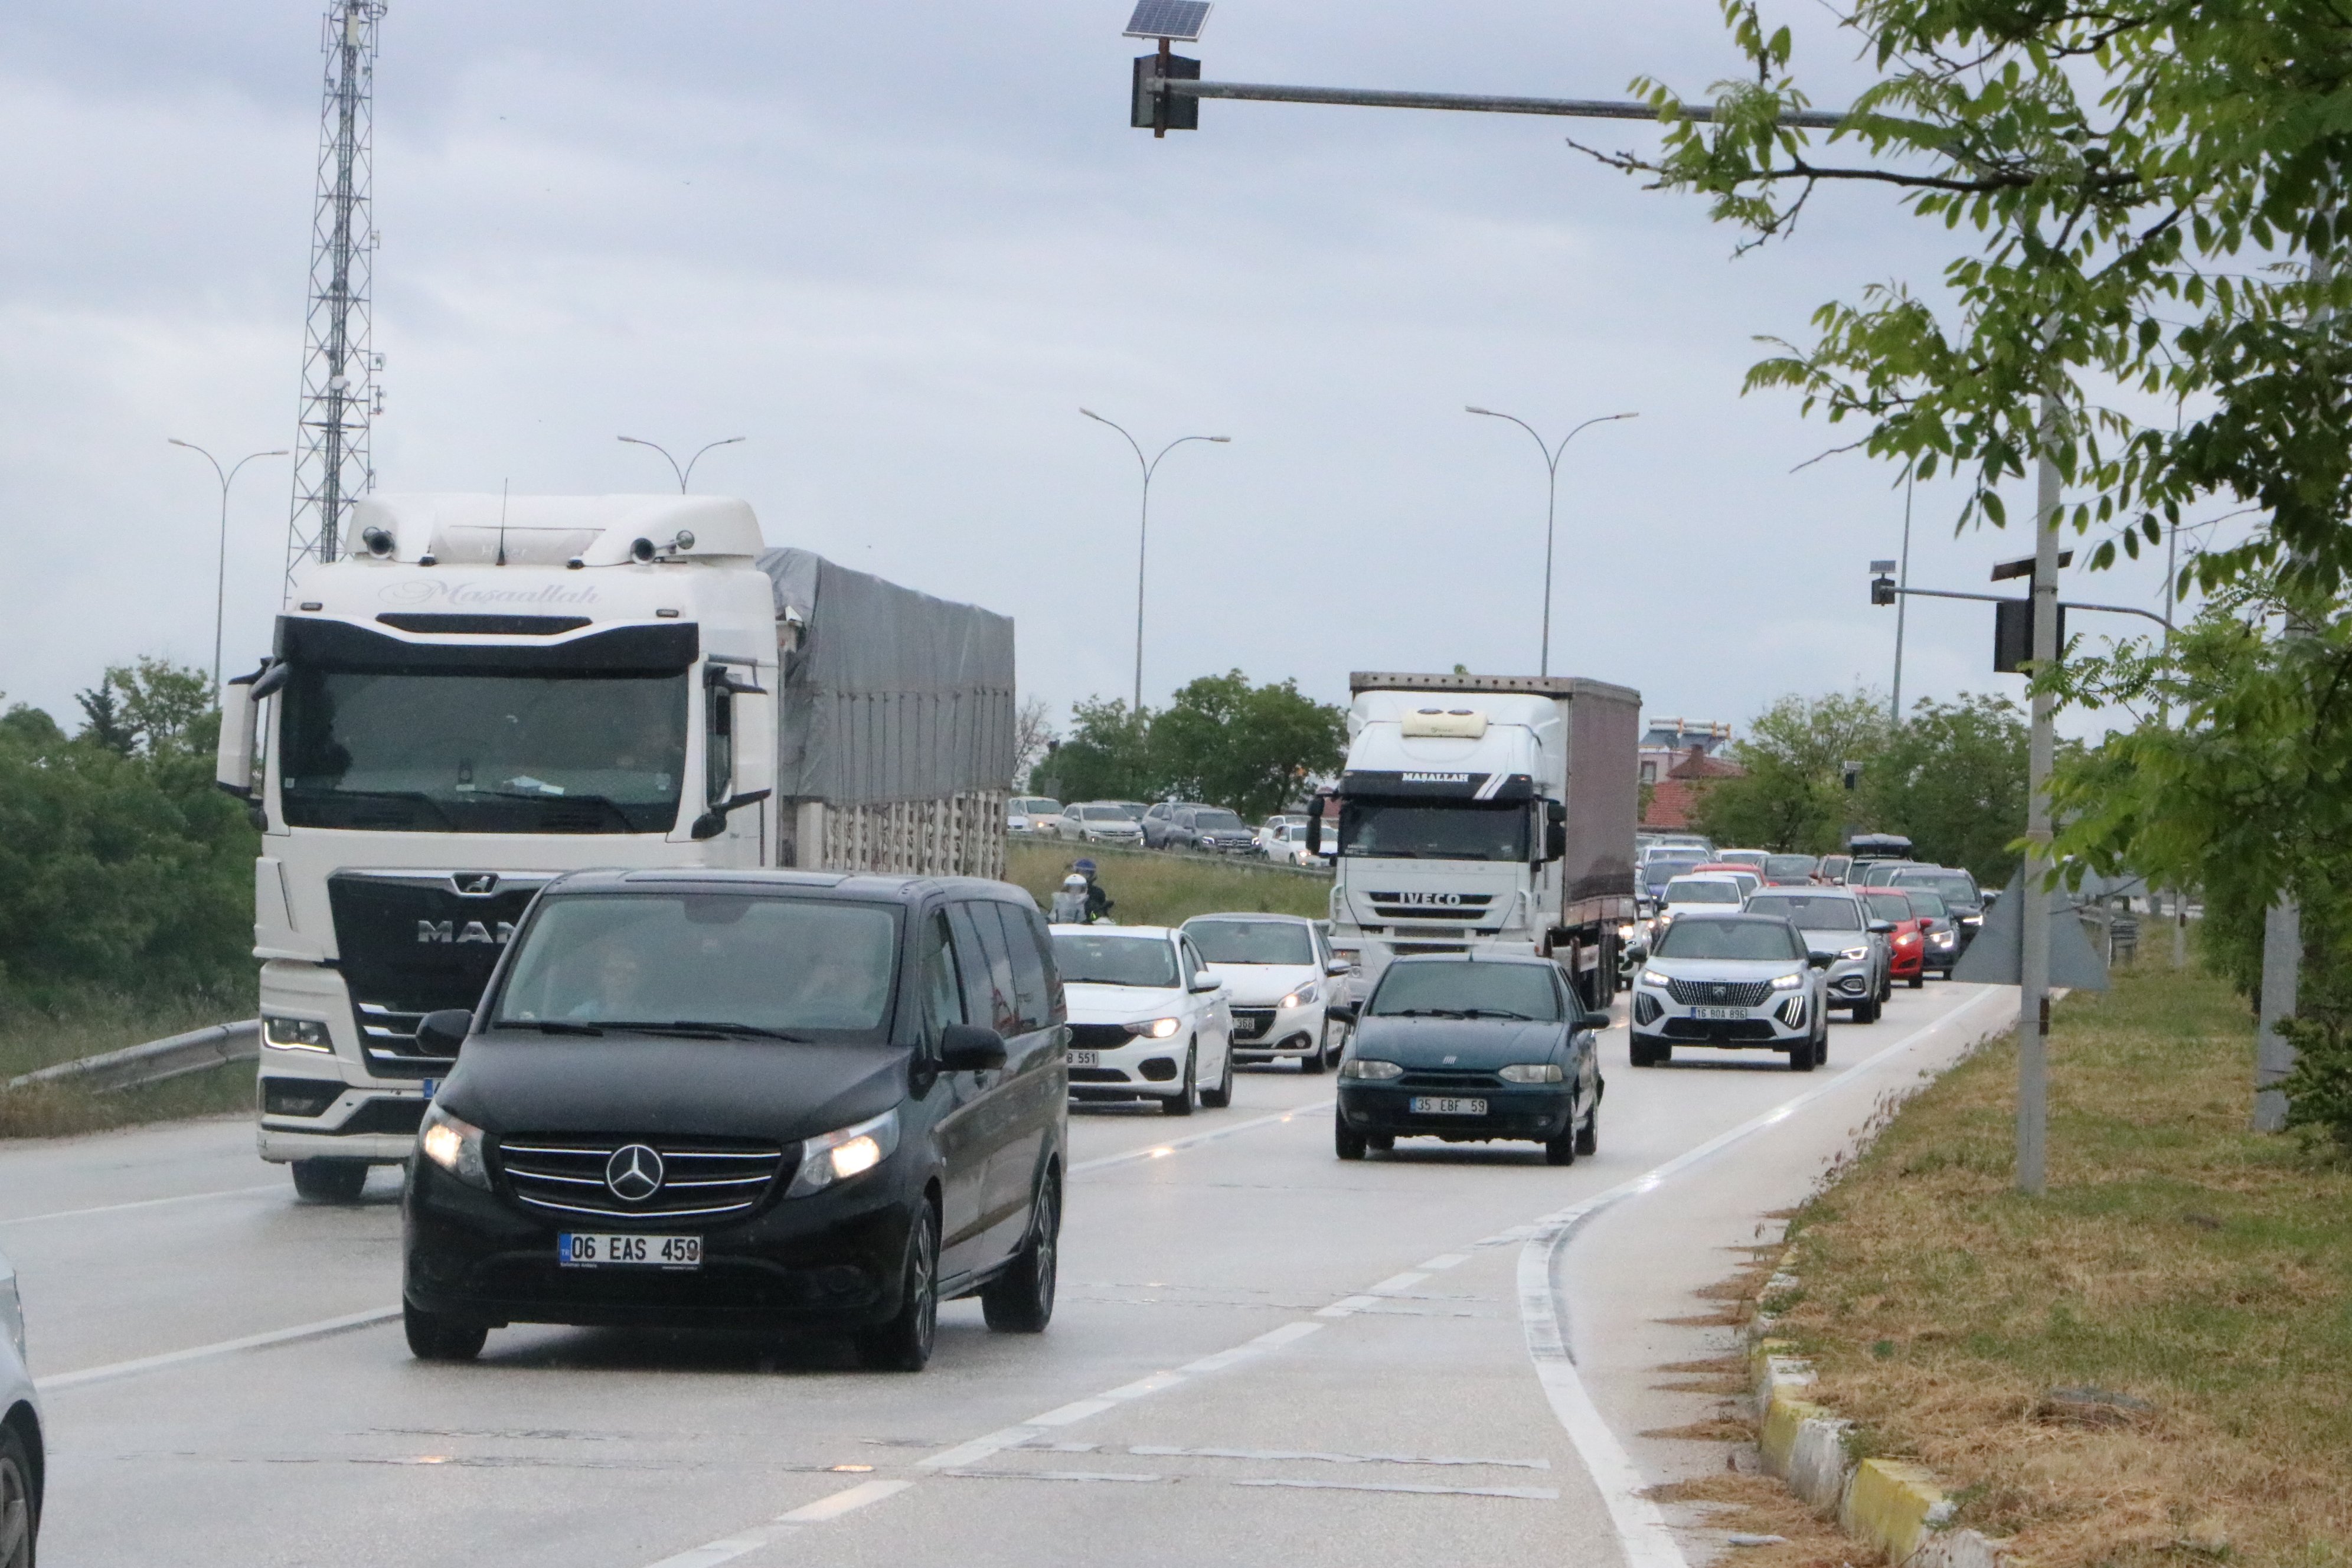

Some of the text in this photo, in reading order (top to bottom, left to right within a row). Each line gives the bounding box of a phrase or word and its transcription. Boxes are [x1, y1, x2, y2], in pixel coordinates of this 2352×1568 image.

[1399, 892, 1461, 906] IVECO
[1697, 1009, 1706, 1018] 16
[1078, 1053, 1095, 1064] 551
[1417, 1099, 1485, 1112] 35 EBF 59
[571, 1236, 596, 1259] 06
[609, 1237, 647, 1260] EAS
[661, 1239, 699, 1261] 459
